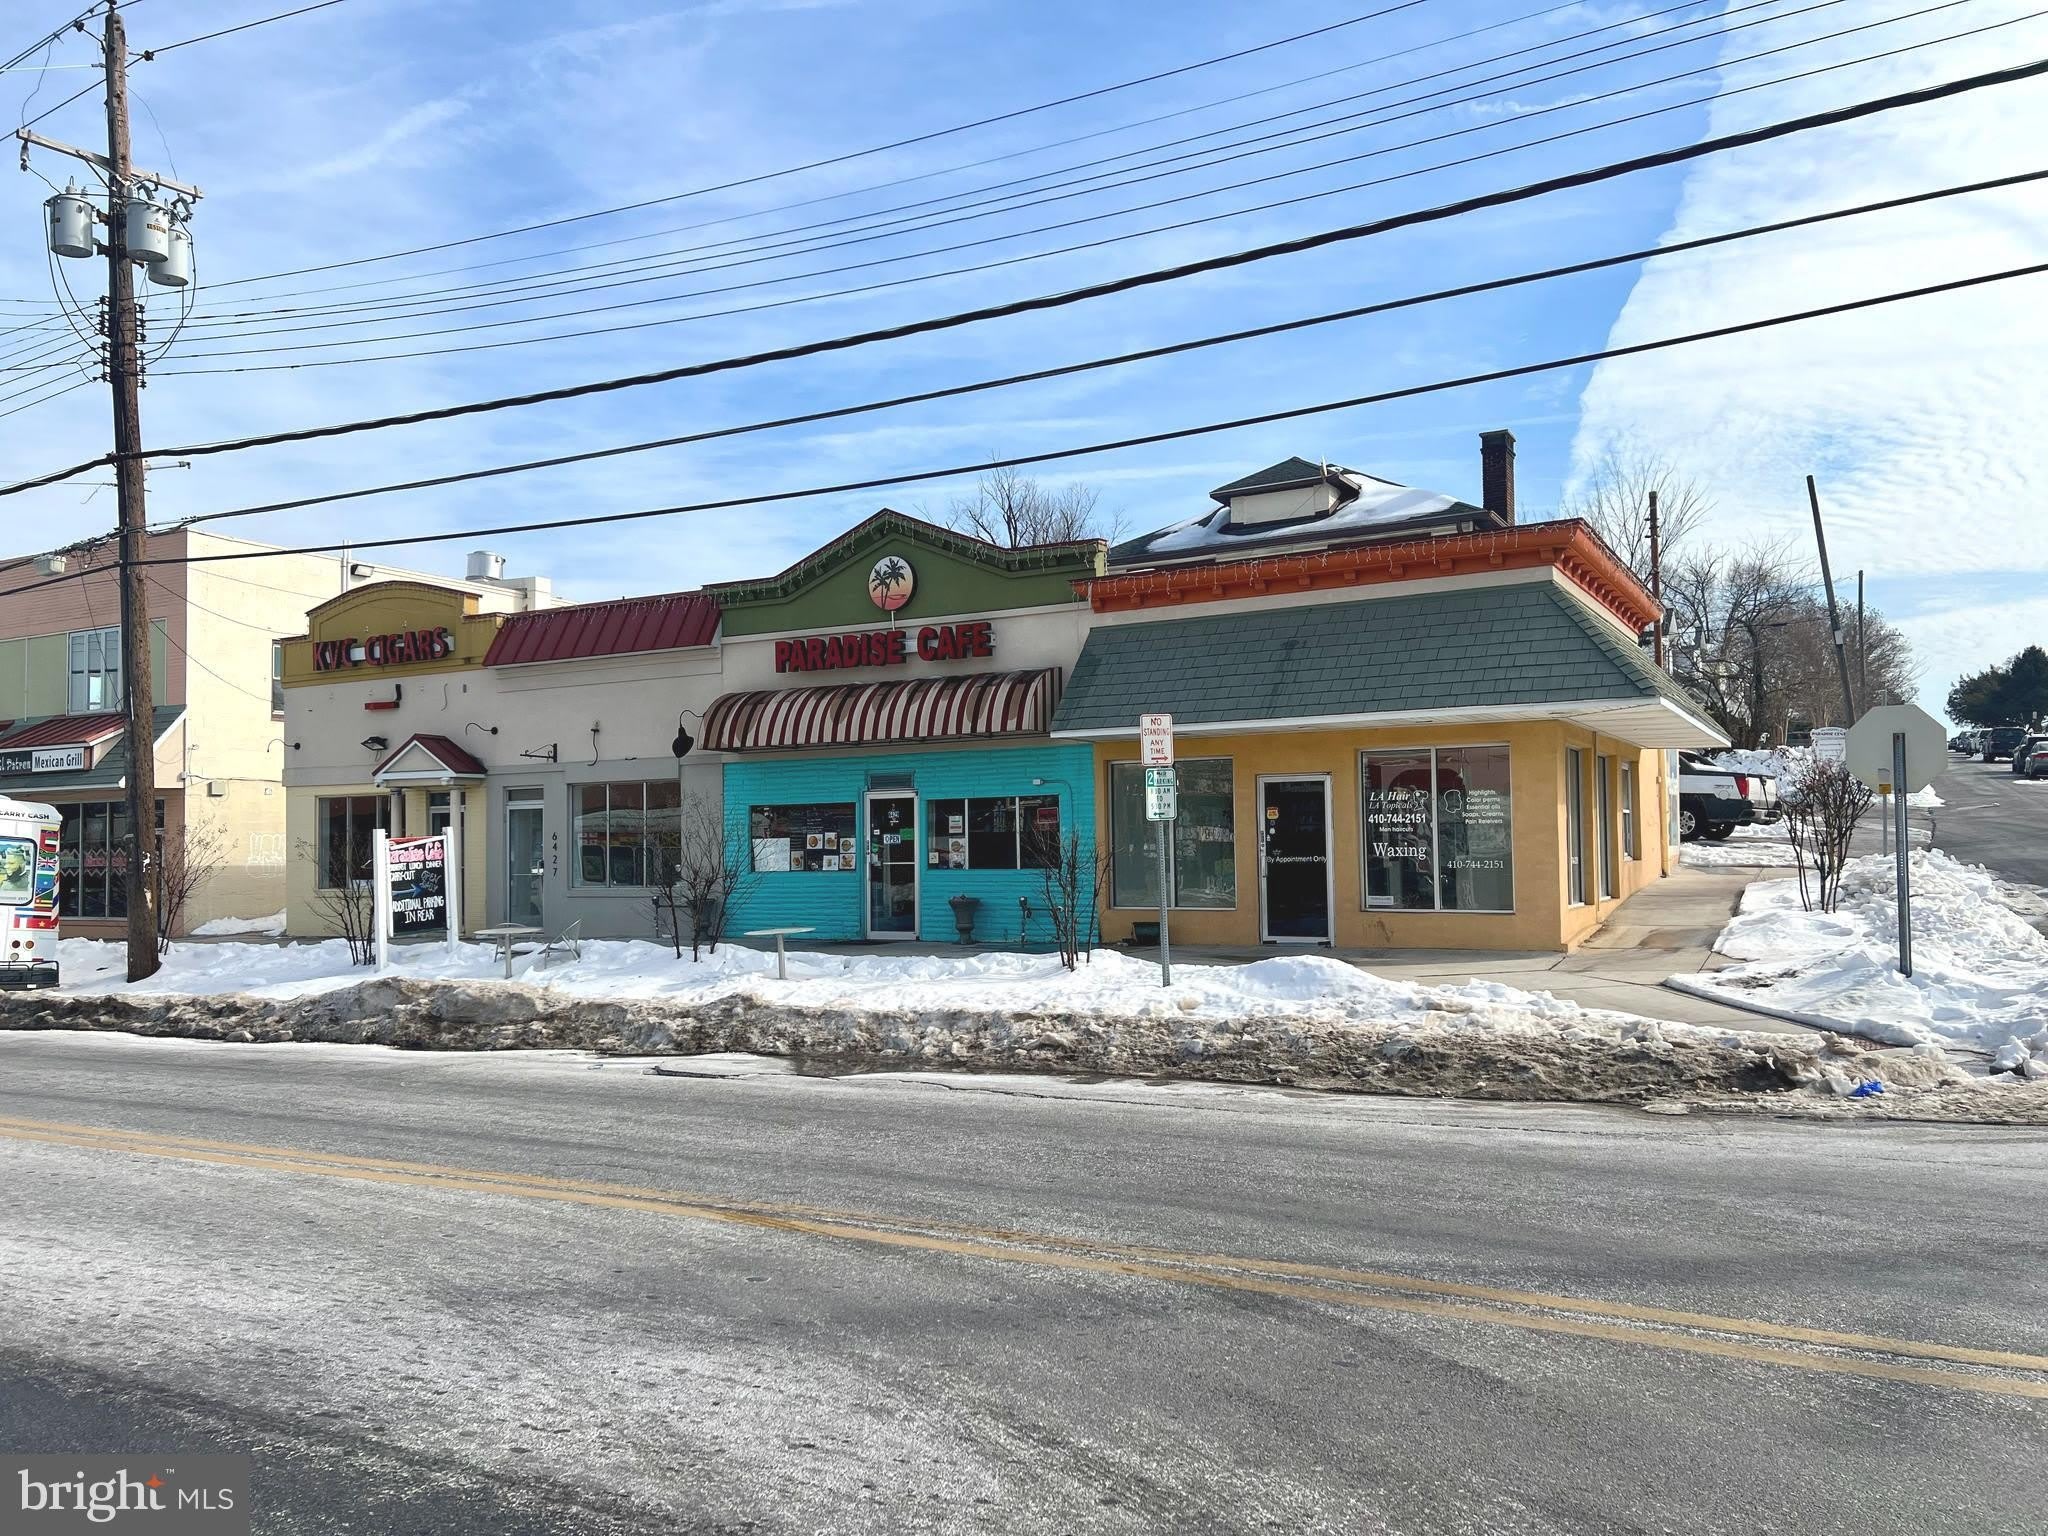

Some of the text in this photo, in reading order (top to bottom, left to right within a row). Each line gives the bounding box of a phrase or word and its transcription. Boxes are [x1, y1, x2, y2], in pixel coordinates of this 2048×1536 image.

[312, 624, 451, 672] KVC CIGARS
[774, 621, 993, 674] PARADISE CAFE
[1150, 717, 1162, 727] NO
[1143, 727, 1170, 737] STANDING
[1150, 747, 1166, 755] TIME
[34, 752, 83, 769] Mexican Grill
[1147, 771, 1154, 785] 2
[1370, 791, 1411, 801] LA Hair
[1369, 801, 1413, 810] LA Topicals
[1368, 813, 1426, 824] 410-744-2151
[884, 835, 900, 844] OPEN
[1372, 842, 1427, 861] Waxing
[1276, 855, 1313, 864] Appointment
[1313, 855, 1328, 864] Only
[1446, 860, 1505, 869] 410-744-2151
[404, 909, 435, 924] IN REAR
